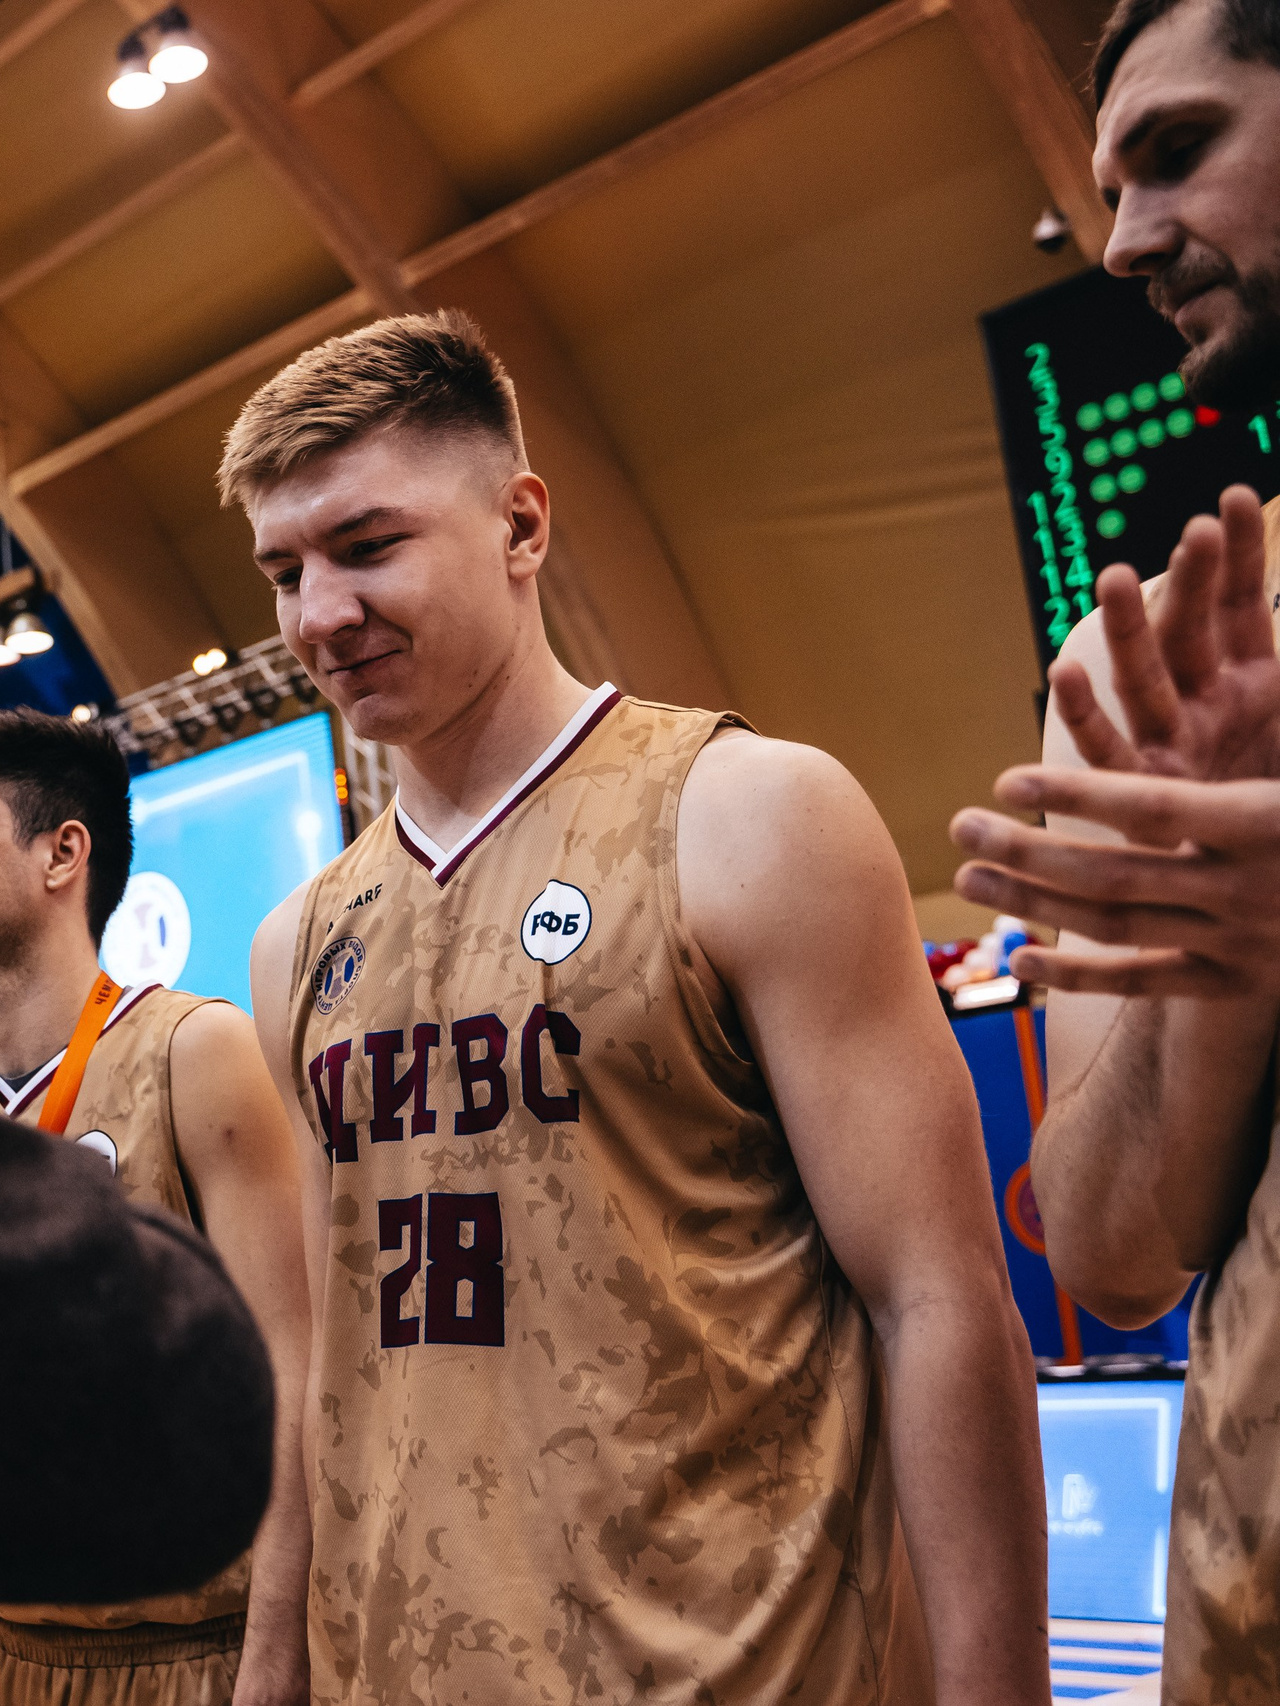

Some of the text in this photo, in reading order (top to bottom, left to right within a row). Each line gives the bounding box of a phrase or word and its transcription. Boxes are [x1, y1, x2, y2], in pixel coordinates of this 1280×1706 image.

[1024, 342, 1051, 381] 2
[1044, 448, 1073, 485] 9
[531, 911, 581, 936] РФБ
[315, 942, 346, 992] ИГРОВЫХ
[377, 1191, 505, 1349] 28
